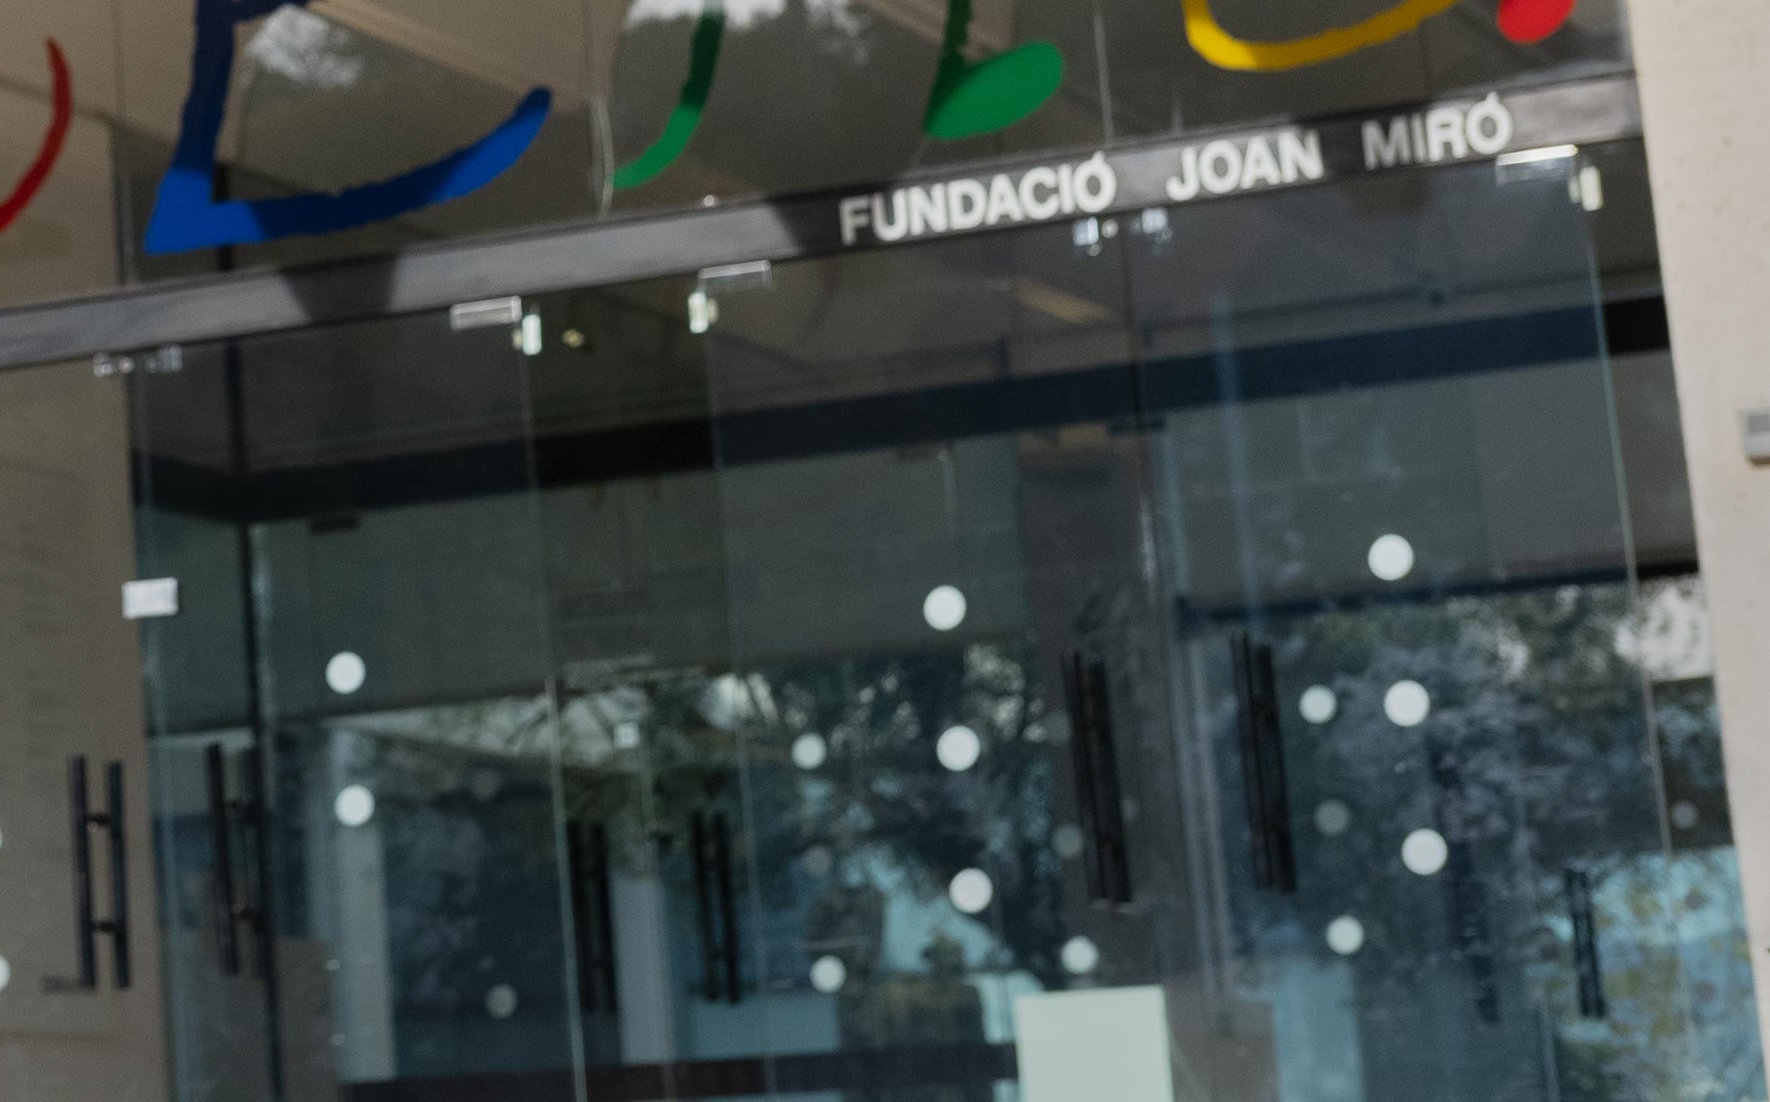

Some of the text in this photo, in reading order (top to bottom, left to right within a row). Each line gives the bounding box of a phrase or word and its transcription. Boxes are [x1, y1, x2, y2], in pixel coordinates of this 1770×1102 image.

[838, 92, 1514, 247] FUNDACIÓ JOAN MIRÓ
